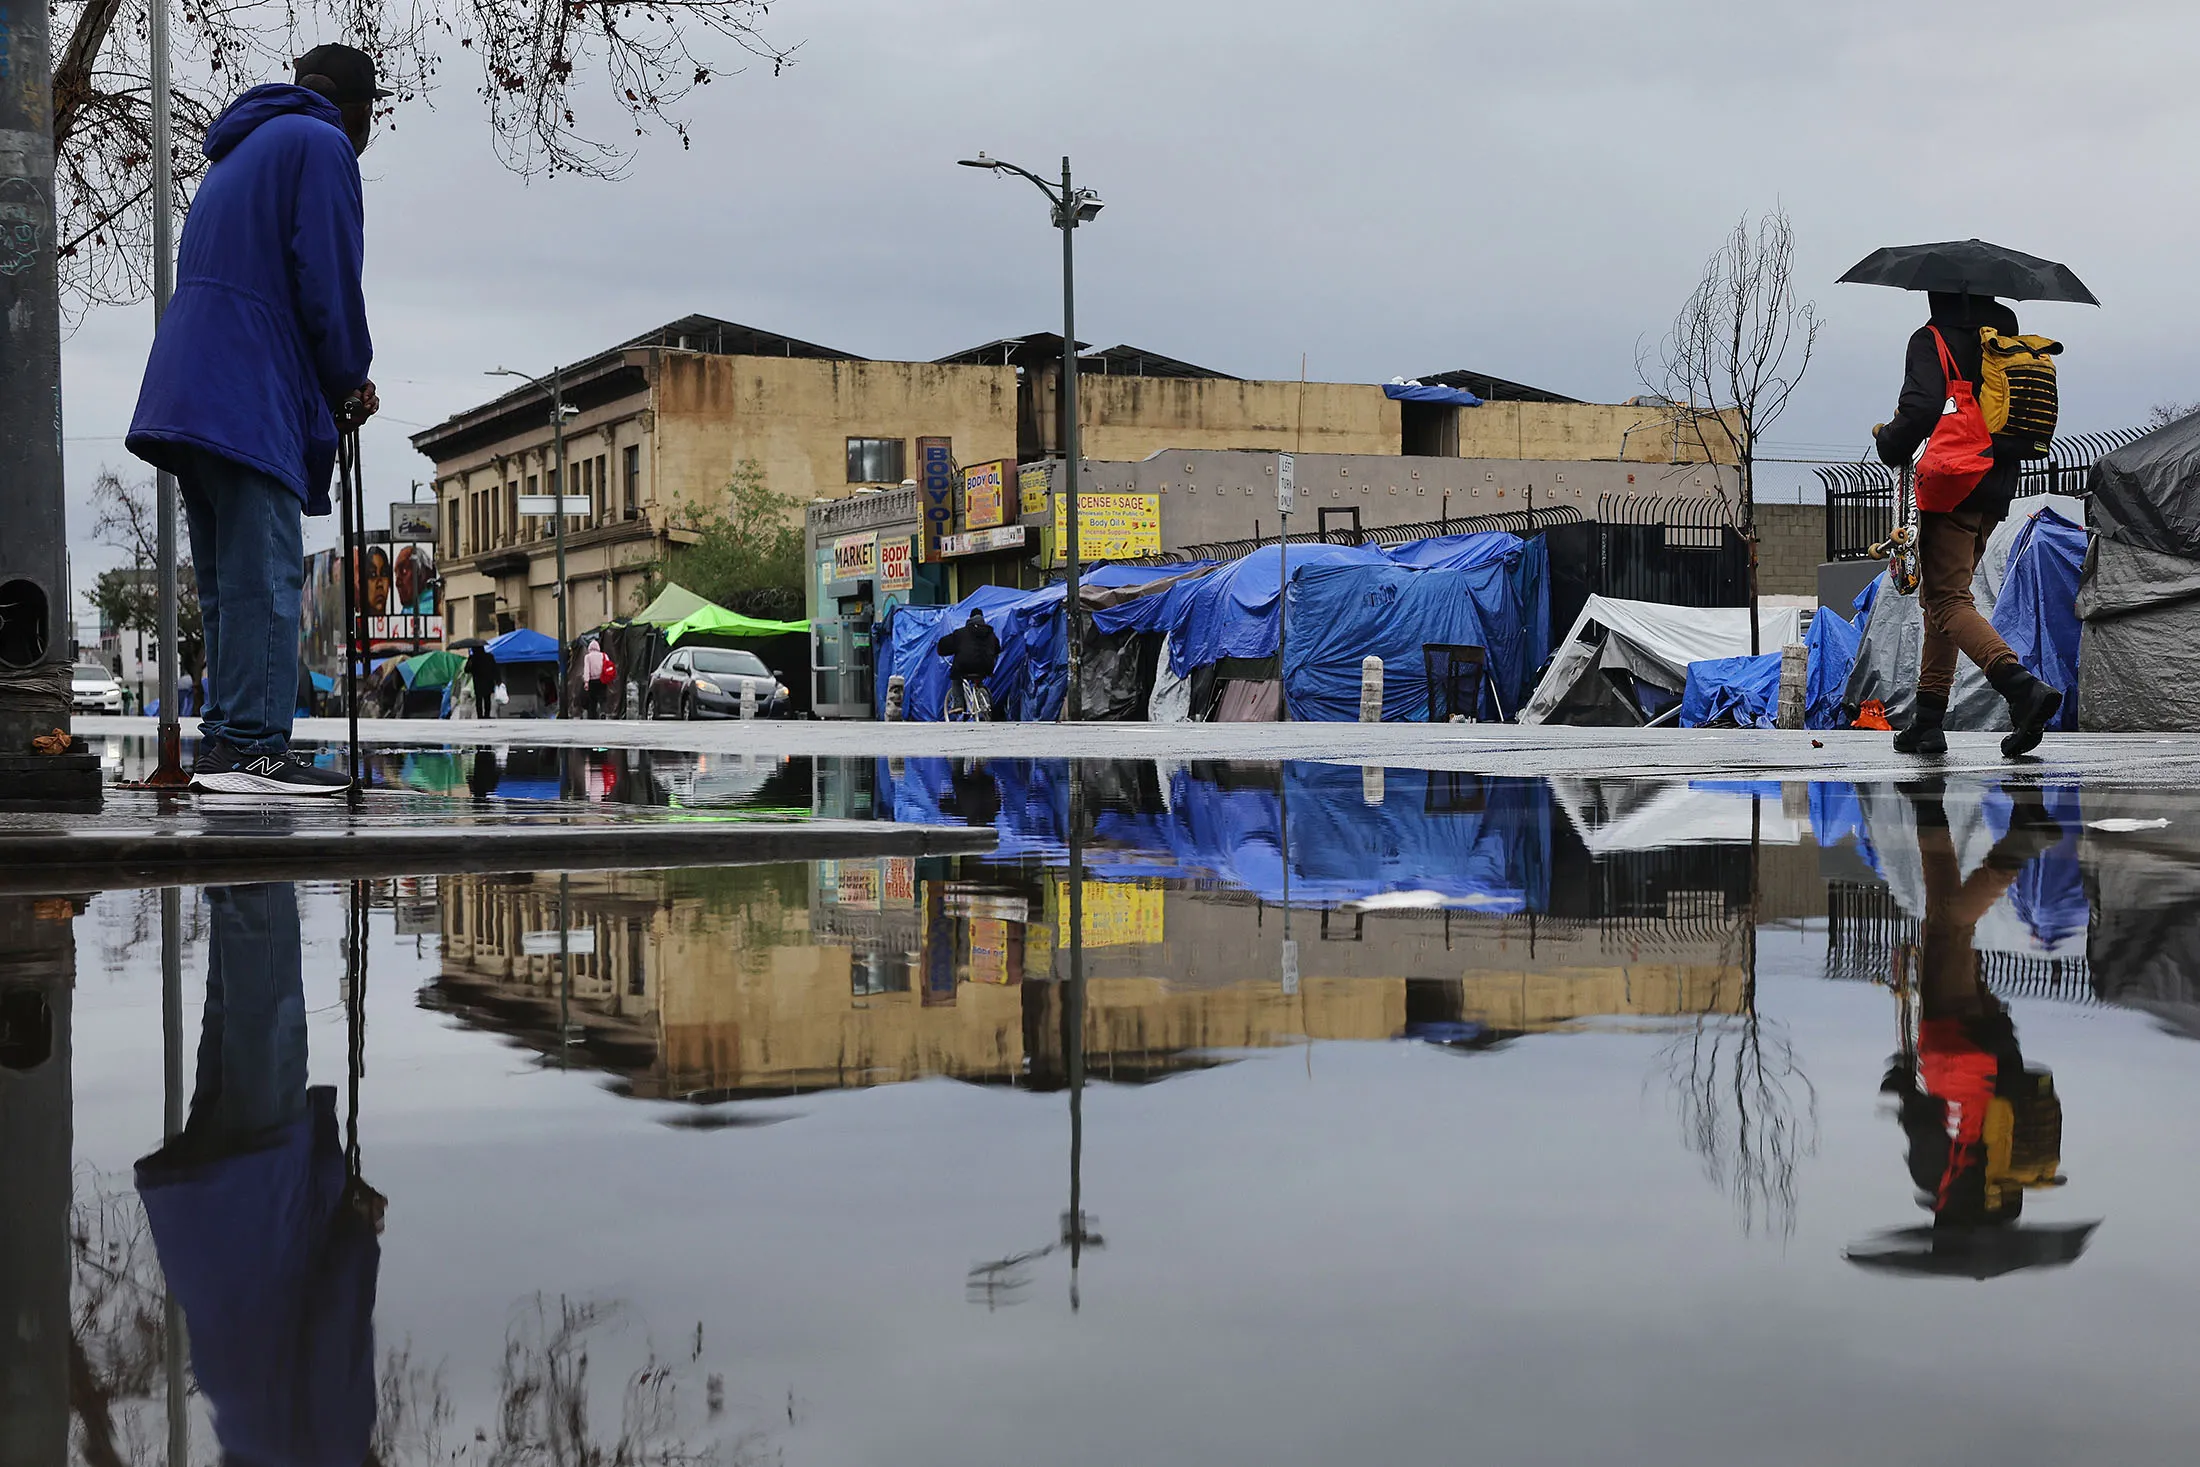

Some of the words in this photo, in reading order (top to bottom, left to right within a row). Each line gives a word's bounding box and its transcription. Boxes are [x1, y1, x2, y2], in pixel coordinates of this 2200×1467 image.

[1282, 459, 1292, 473] LEFT
[967, 474, 986, 491] BODY
[987, 472, 1001, 485] OIL
[1281, 477, 1292, 489] TURN
[1118, 497, 1144, 510] SAGE
[1089, 518, 1108, 528] Body
[1109, 518, 1120, 527] Oil
[834, 542, 875, 569] MARKET
[882, 544, 909, 563] BODY
[887, 562, 904, 578] OIL
